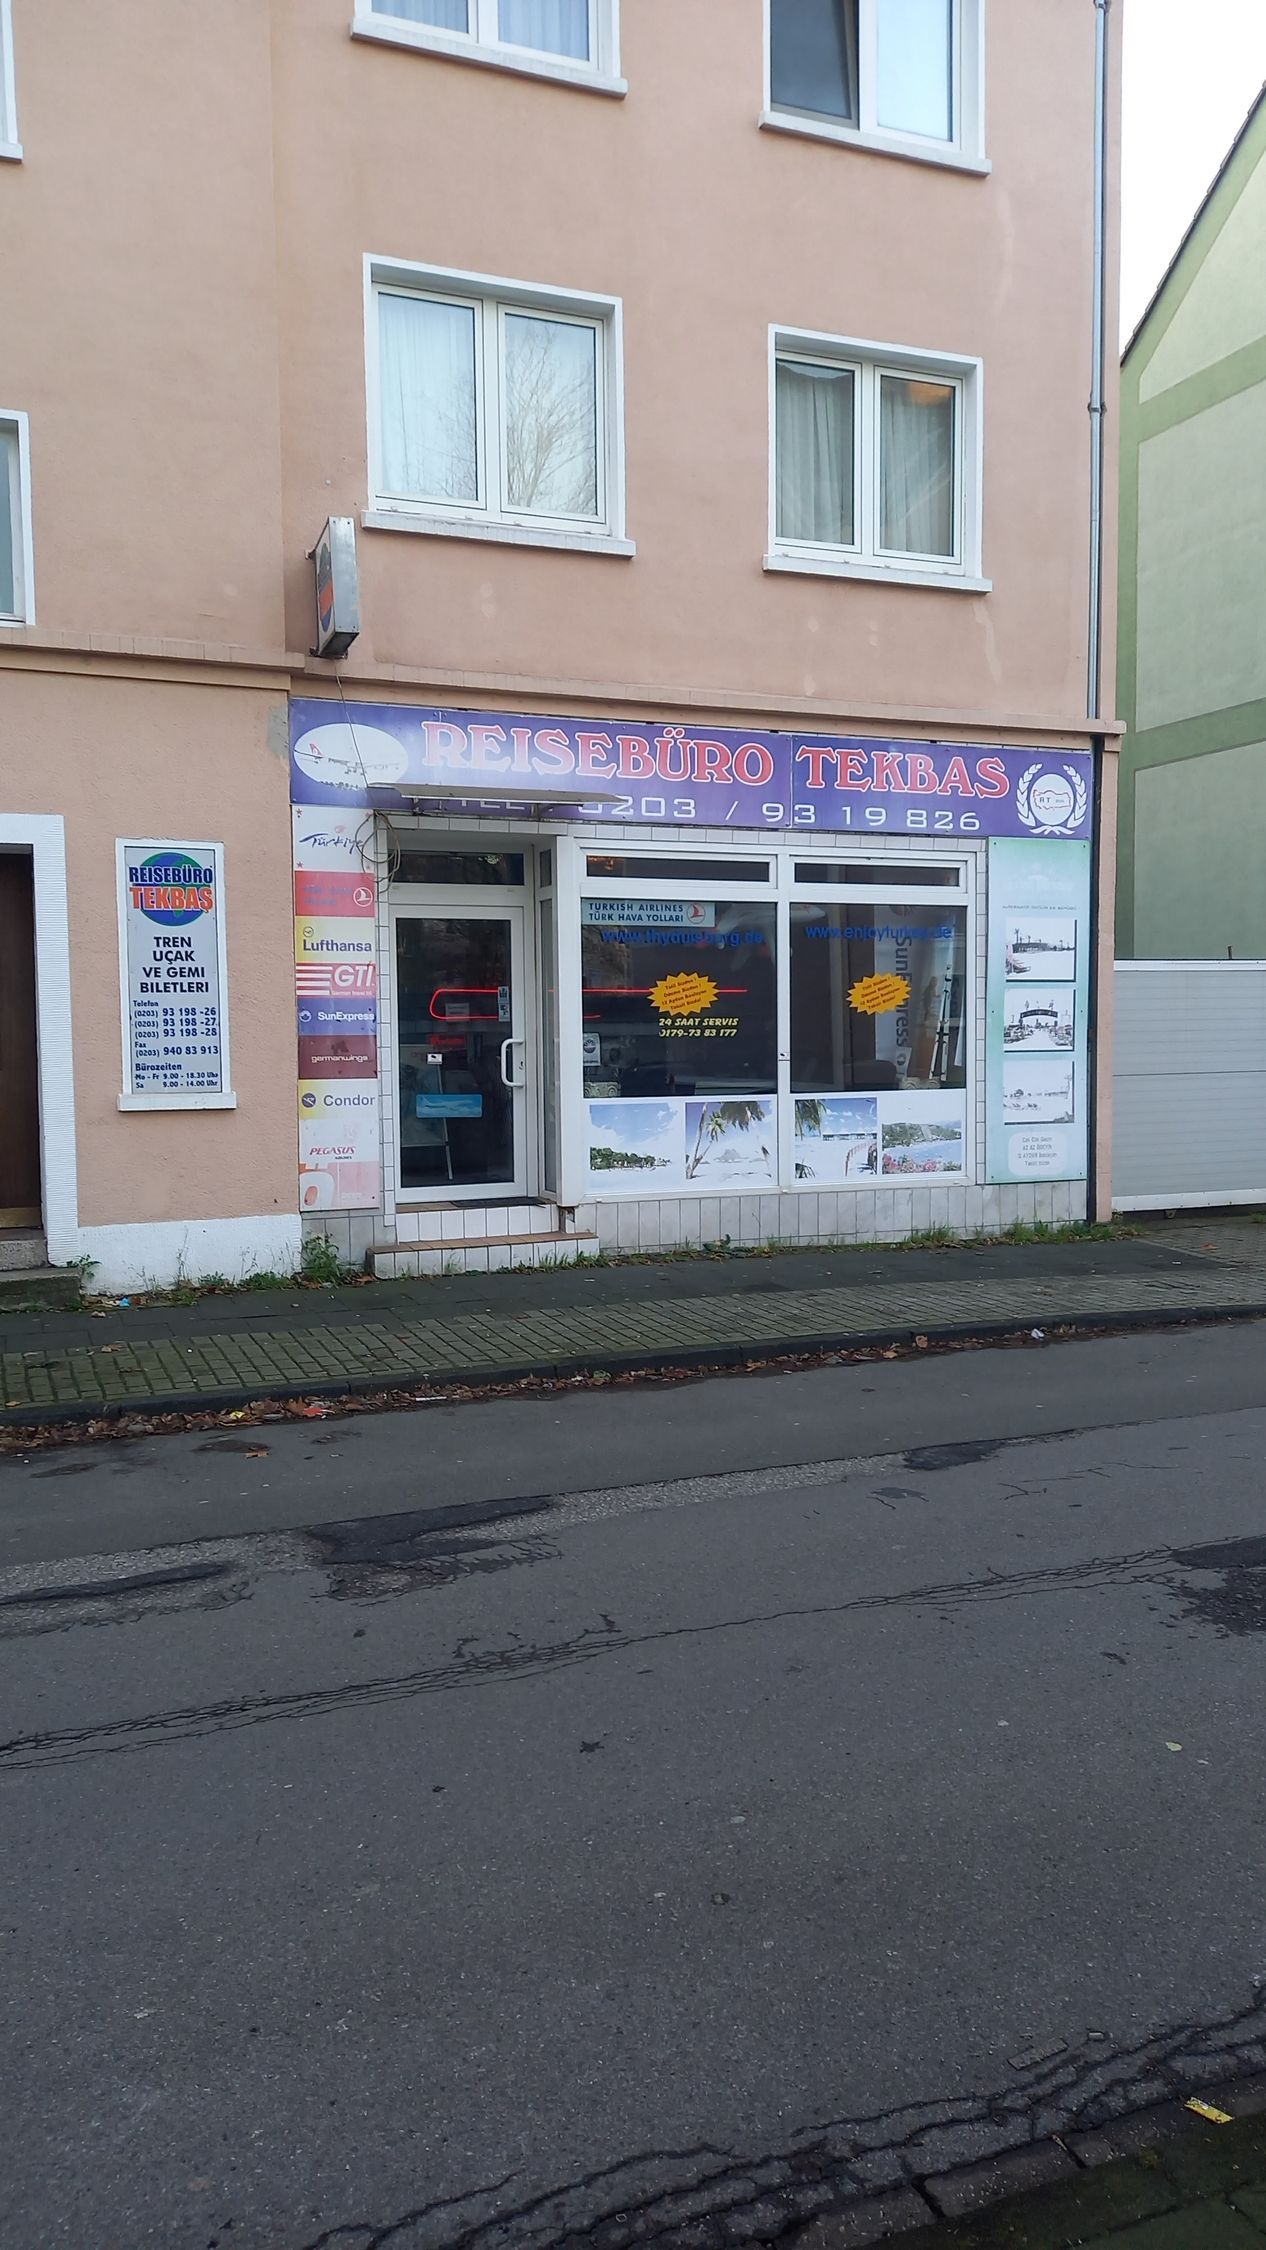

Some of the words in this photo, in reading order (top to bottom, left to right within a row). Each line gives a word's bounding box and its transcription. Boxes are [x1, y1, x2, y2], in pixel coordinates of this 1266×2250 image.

[421, 720, 774, 786] REISEBÜRO
[796, 746, 1010, 798] TEKBAS
[725, 800, 738, 821] /
[762, 803, 815, 823] 93
[842, 806, 887, 826] 19
[906, 809, 980, 831] 826
[128, 864, 213, 884] REISEBÜRO
[129, 886, 214, 914] TEKBAŞ
[589, 903, 633, 911] TURKISH
[639, 904, 684, 912] AIRLINES
[590, 912, 614, 921] TÜRK
[618, 914, 643, 922] HAVA
[647, 914, 684, 922] YOLLARI
[154, 936, 192, 948] TREN
[303, 939, 372, 952] Lufthansa
[153, 951, 196, 965] UÇAK
[142, 967, 161, 978] VE
[166, 967, 205, 978] GEMI
[140, 982, 209, 993] BILETLERI
[134, 1010, 159, 1018] (0203)
[162, 1007, 175, 1016] 93
[179, 1007, 197, 1016] 198
[318, 1011, 375, 1021] SunExpress
[134, 1020, 159, 1029] (0203)
[162, 1018, 175, 1027] 93
[180, 1017, 197, 1026] 198
[659, 1018, 672, 1027] 24
[675, 1018, 701, 1027] SAAT
[703, 1018, 739, 1026] SERVIS
[135, 1031, 159, 1040] (0203)
[163, 1028, 176, 1037] 93
[180, 1028, 198, 1037] 198
[659, 1029, 701, 1037] 0179-73
[704, 1029, 716, 1037] 83
[719, 1029, 737, 1037] 177
[135, 1049, 160, 1058] (0203)
[163, 1046, 182, 1055] 940
[185, 1046, 197, 1055] 83
[200, 1045, 219, 1054] 913
[311, 1055, 368, 1063] germanwings
[135, 1062, 182, 1071] Bürozeiten
[162, 1072, 179, 1080] 9.00
[186, 1071, 206, 1079] 18.30
[324, 1094, 375, 1106] Condor
[309, 1146, 356, 1155] PEGASUS
